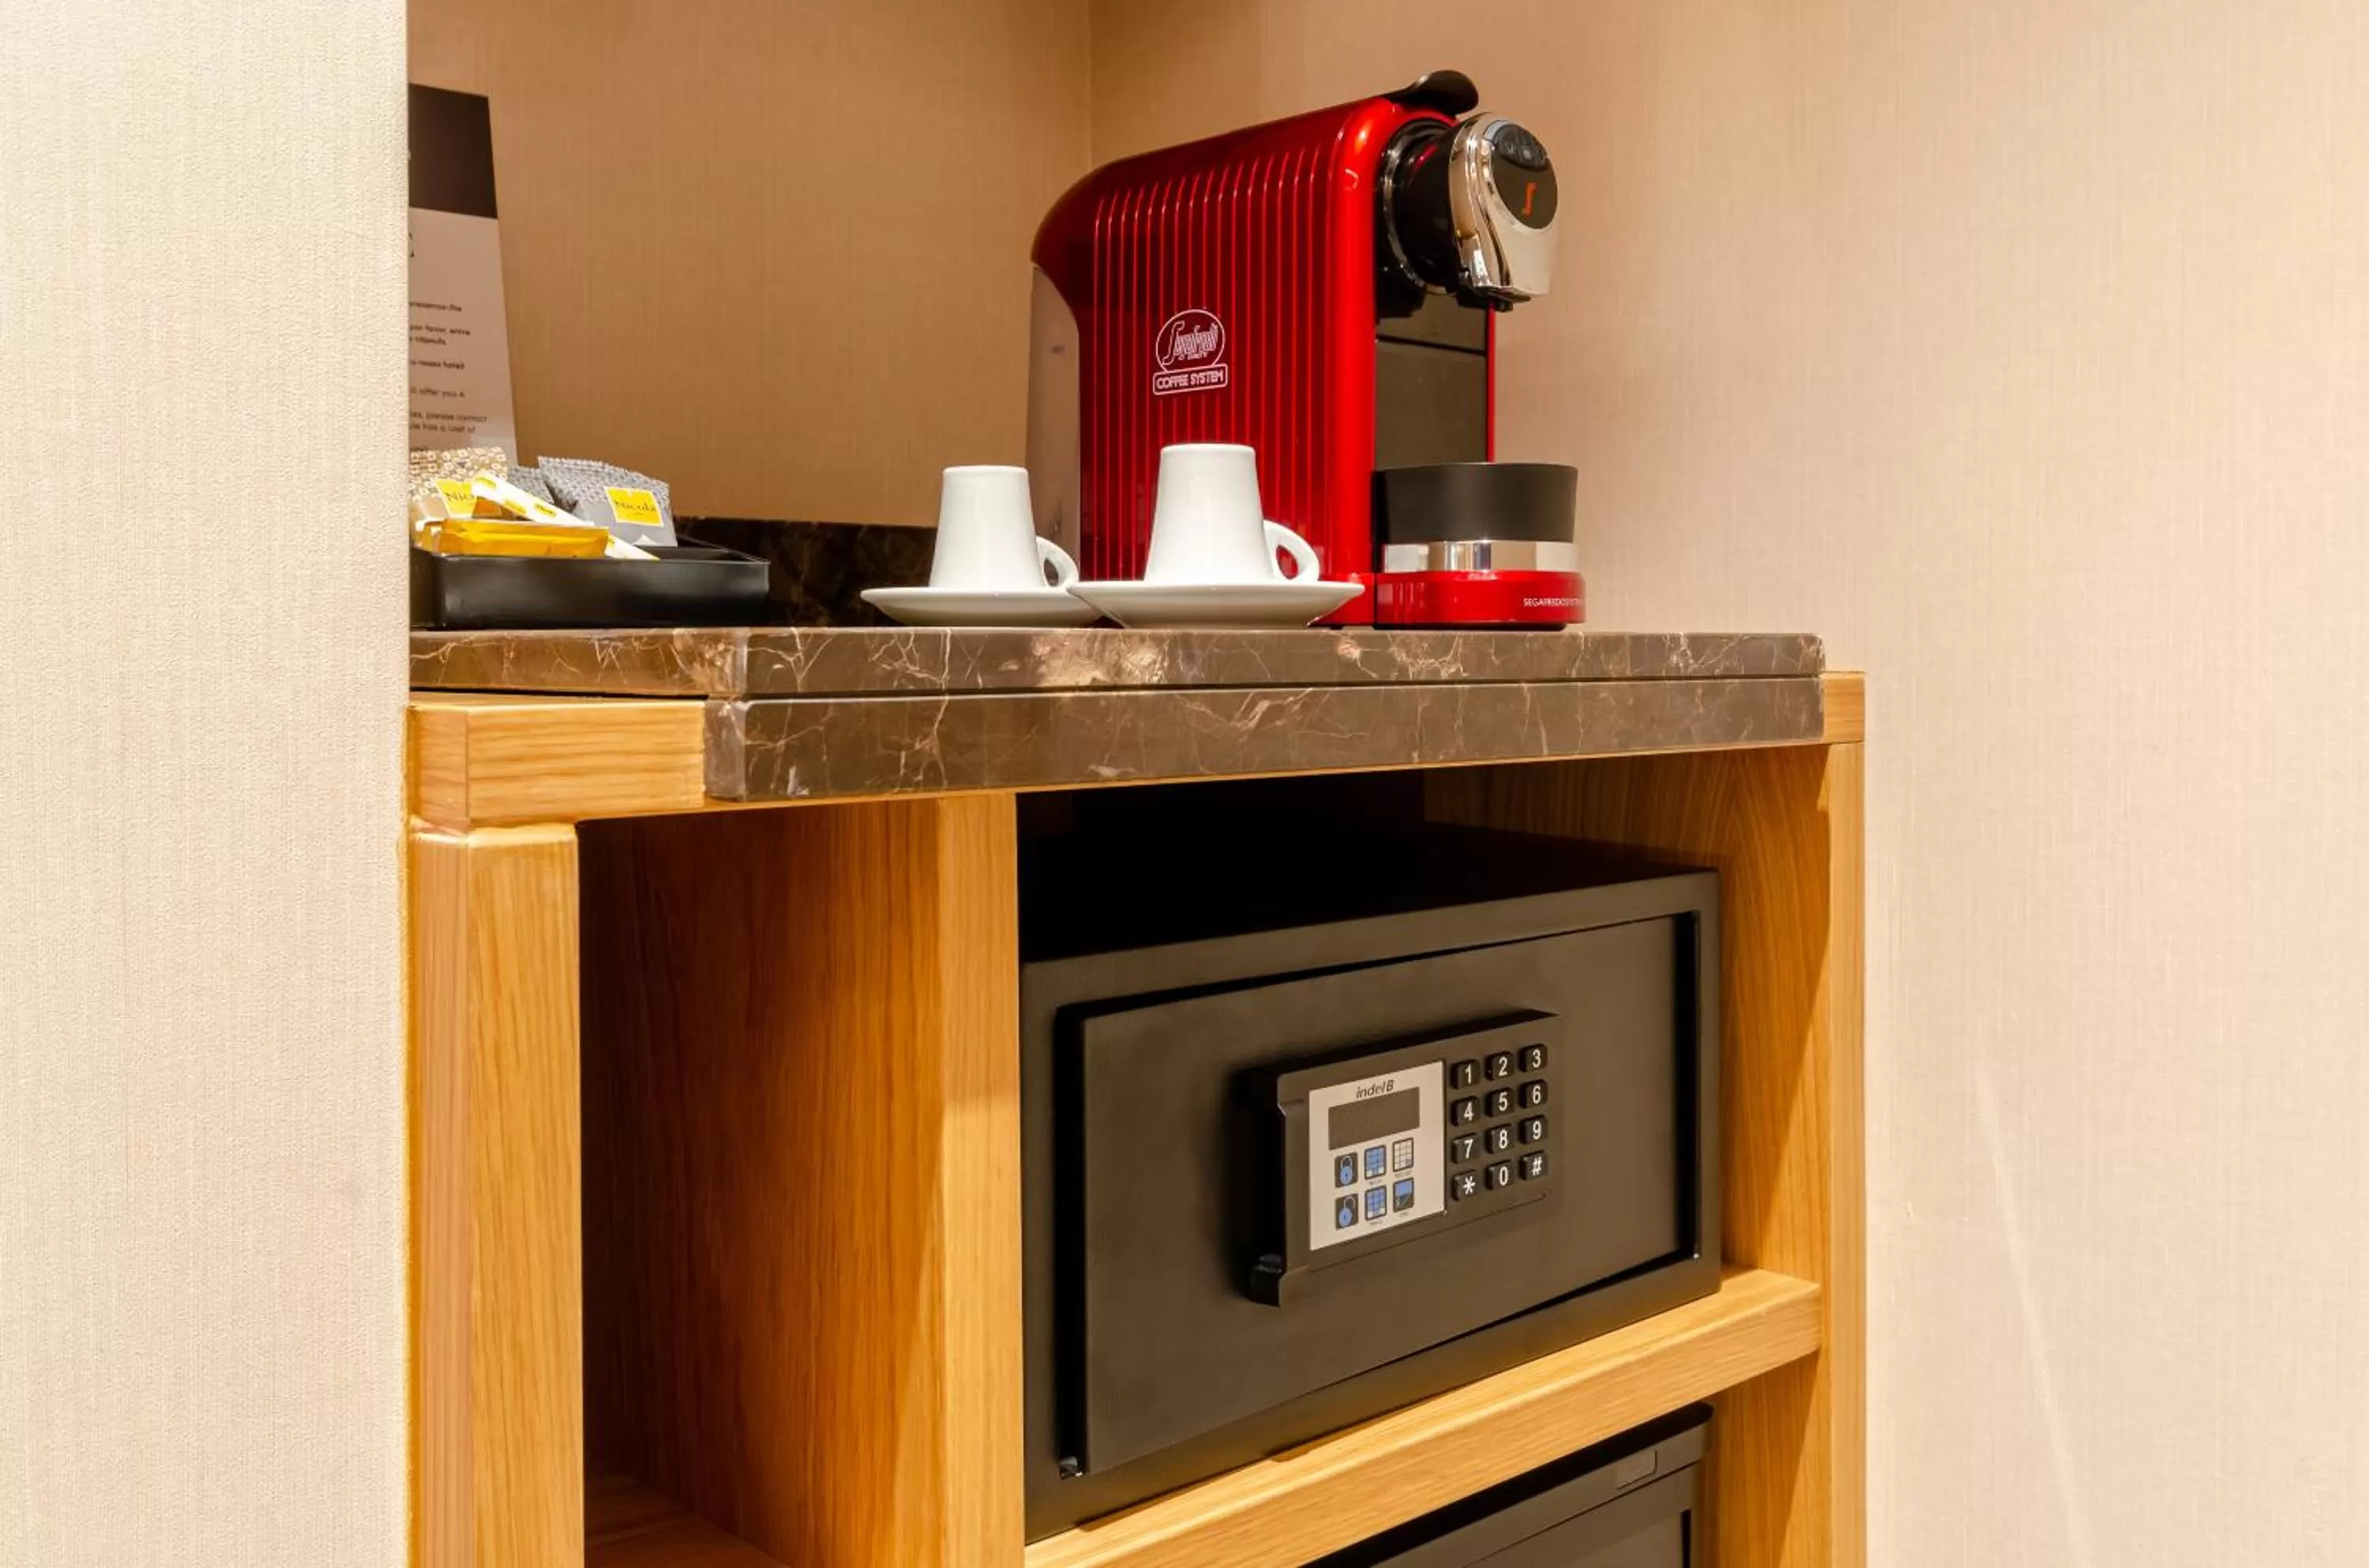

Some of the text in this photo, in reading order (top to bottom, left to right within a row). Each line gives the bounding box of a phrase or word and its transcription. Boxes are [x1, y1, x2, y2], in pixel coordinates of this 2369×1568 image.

[1157, 369, 1223, 389] COFFEE SYSTEM
[1465, 1048, 1541, 1084] 1 2 3
[1463, 1085, 1541, 1121] 4 5 6
[1463, 1120, 1541, 1159] 7 8 9
[1500, 1166, 1509, 1187] 0
